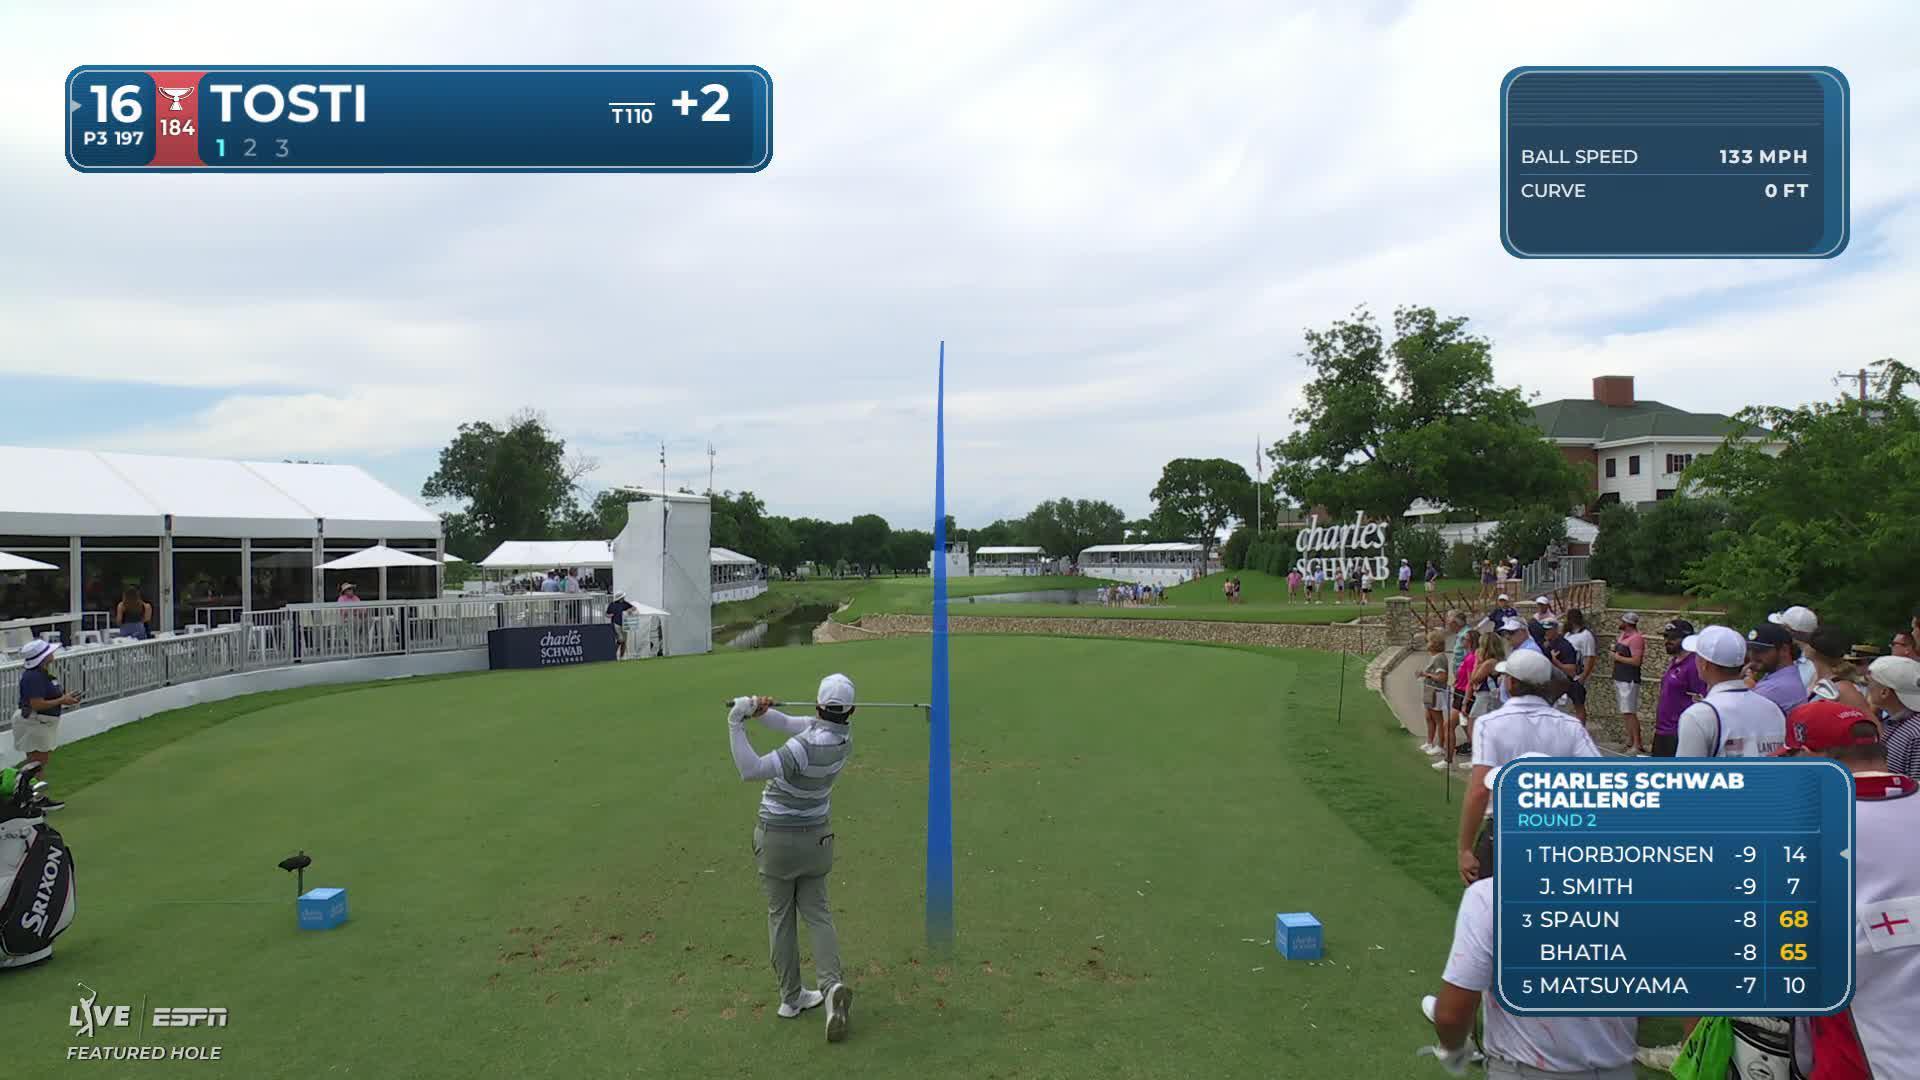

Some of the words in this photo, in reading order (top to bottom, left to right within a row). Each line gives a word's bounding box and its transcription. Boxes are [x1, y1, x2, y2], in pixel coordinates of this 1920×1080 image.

[1296, 510, 1388, 552] charles
[1296, 556, 1390, 581] SCHWAB
[540, 630, 582, 646] charles
[541, 646, 583, 658] SCHWAB
[21, 846, 64, 937] SRIXON
